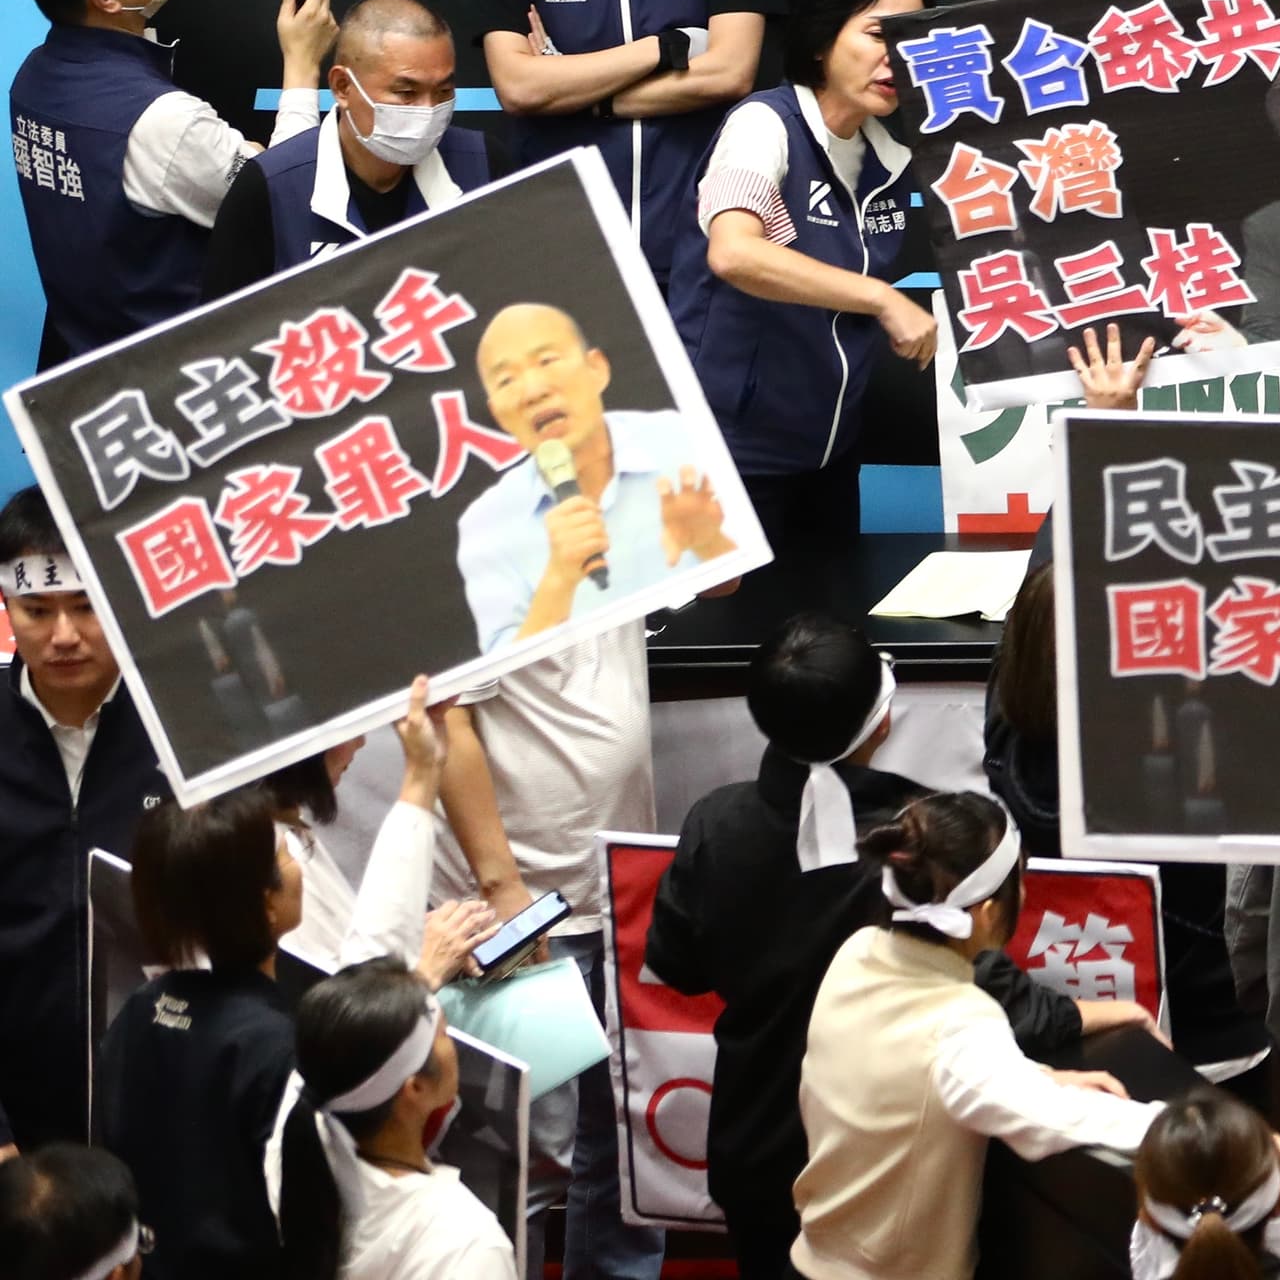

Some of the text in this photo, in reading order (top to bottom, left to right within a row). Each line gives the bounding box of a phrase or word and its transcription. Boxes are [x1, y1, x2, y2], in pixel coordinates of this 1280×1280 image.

[15, 115, 67, 155] 立法委員
[931, 120, 1126, 241] 台灣
[957, 223, 1258, 352] 吳三桂
[72, 267, 477, 510] 民主殺手
[118, 390, 530, 618] 國家罪人
